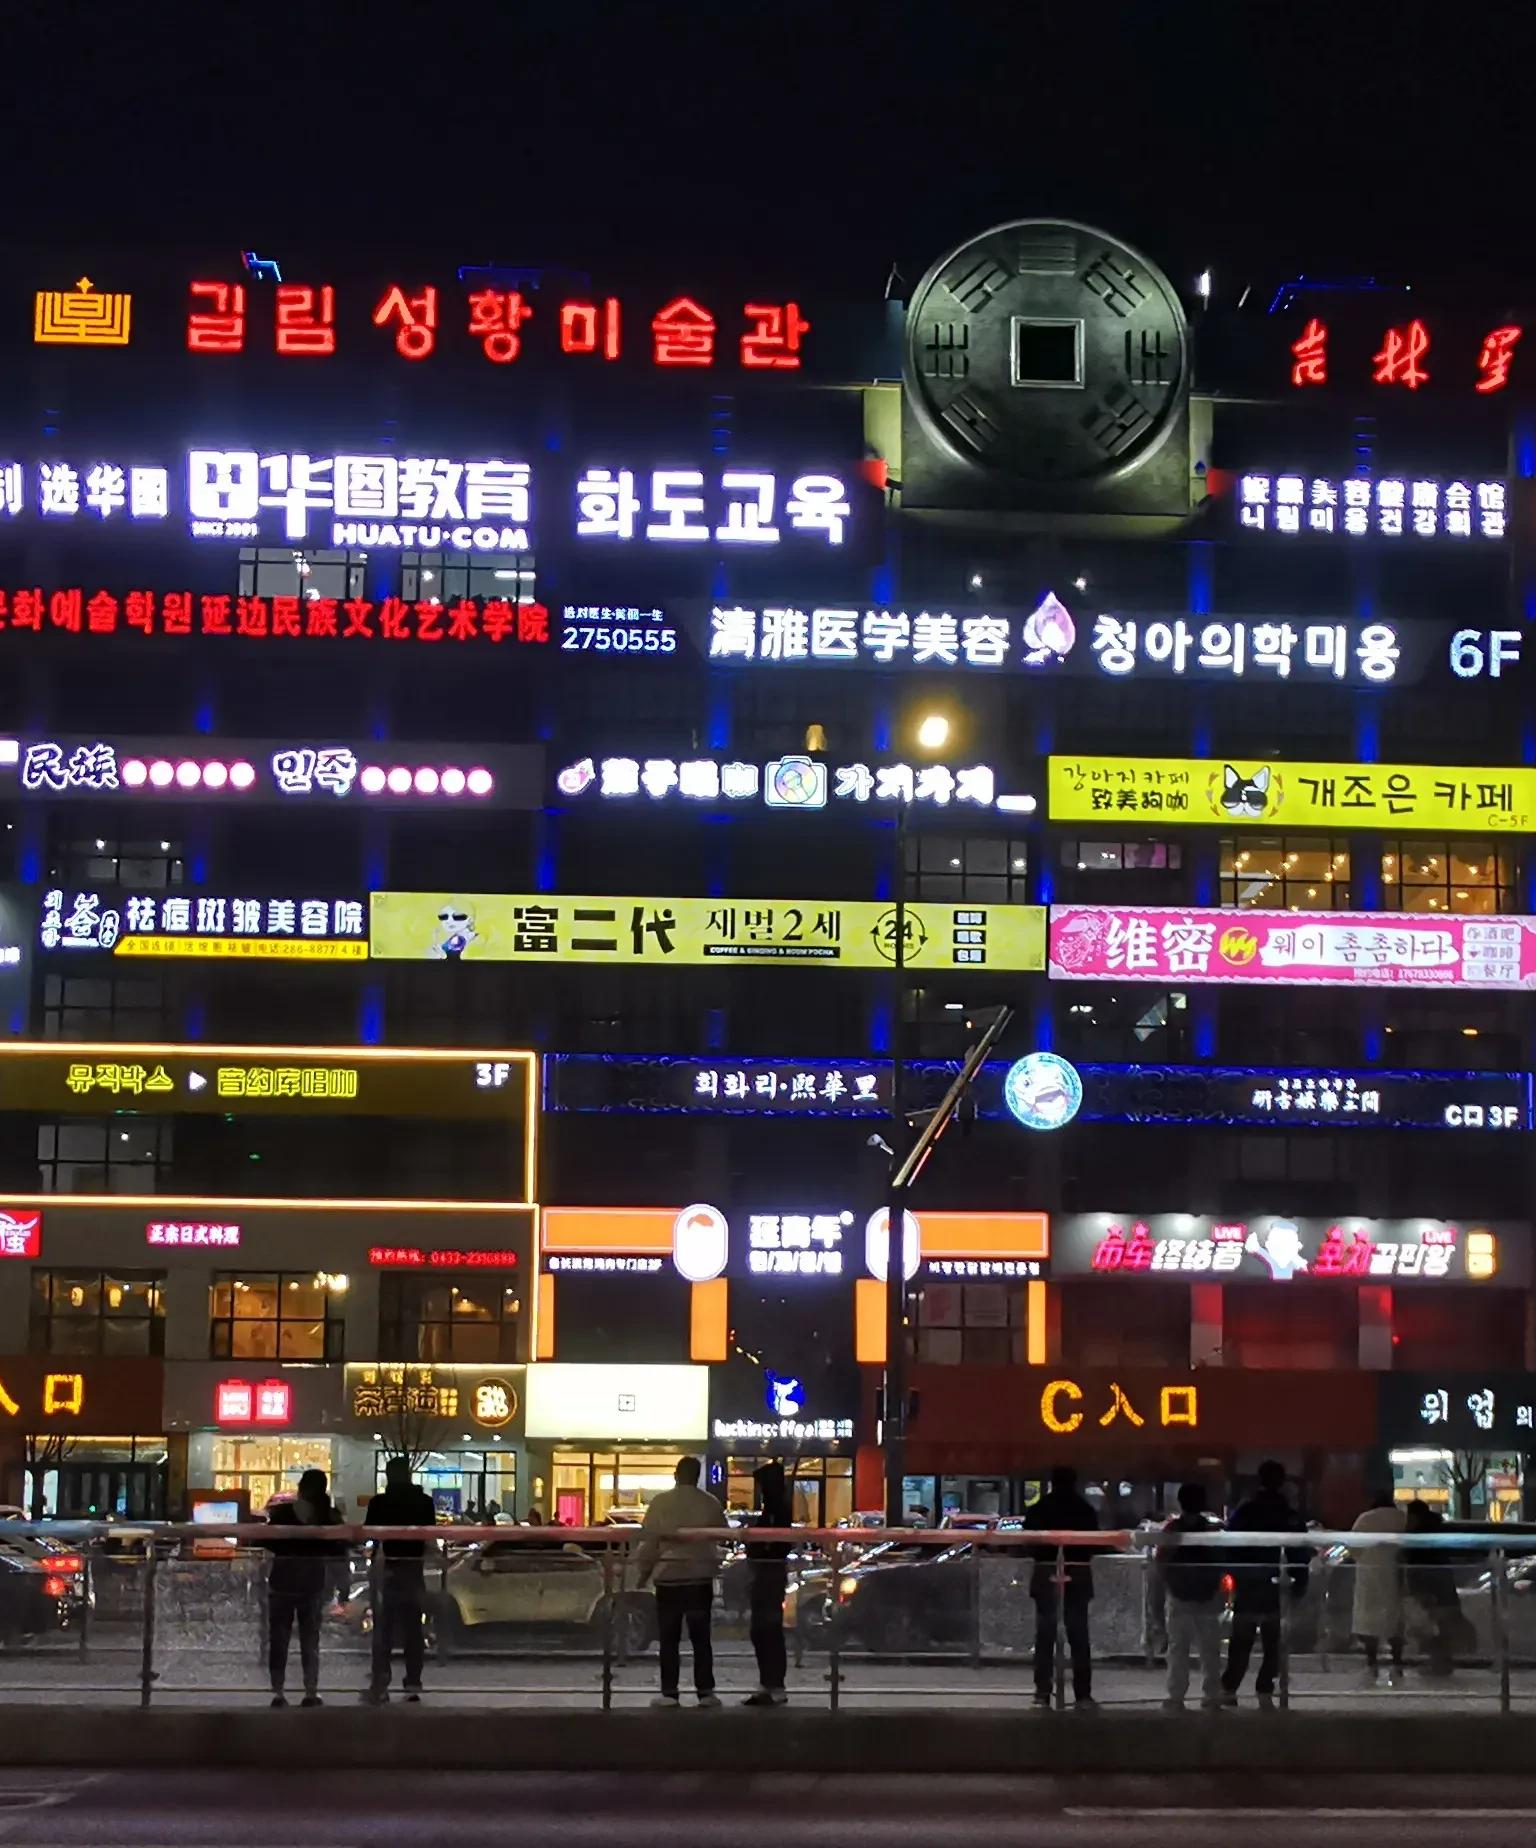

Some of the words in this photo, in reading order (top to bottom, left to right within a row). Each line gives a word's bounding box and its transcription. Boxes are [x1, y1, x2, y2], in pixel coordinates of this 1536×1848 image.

[259, 453, 530, 539] 华图教育
[576, 467, 851, 545] 화도교육
[200, 594, 550, 643] 延边民族文化艺术学院
[561, 626, 678, 654] 2750555
[709, 606, 1012, 666] 清雅医学美容
[1091, 613, 1402, 683] 청아의학미용
[1449, 628, 1523, 679] 6F
[22, 743, 120, 790] 民族
[272, 748, 357, 794] 민족
[1063, 763, 1136, 792] 강아지
[1145, 769, 1191, 785] 카페
[1432, 779, 1515, 813] 카페
[512, 903, 678, 956] 富二代
[702, 906, 842, 943] 재벌2세
[884, 918, 914, 942] 24
[1106, 918, 1218, 974] 维密
[1272, 932, 1326, 963] 웨이
[66, 1063, 175, 1094] 뮤직박스
[475, 1062, 511, 1087] 3F
[1488, 1105, 1519, 1128] 3F
[1040, 1379, 1084, 1434] C
[1098, 1381, 1198, 1428] 入口
